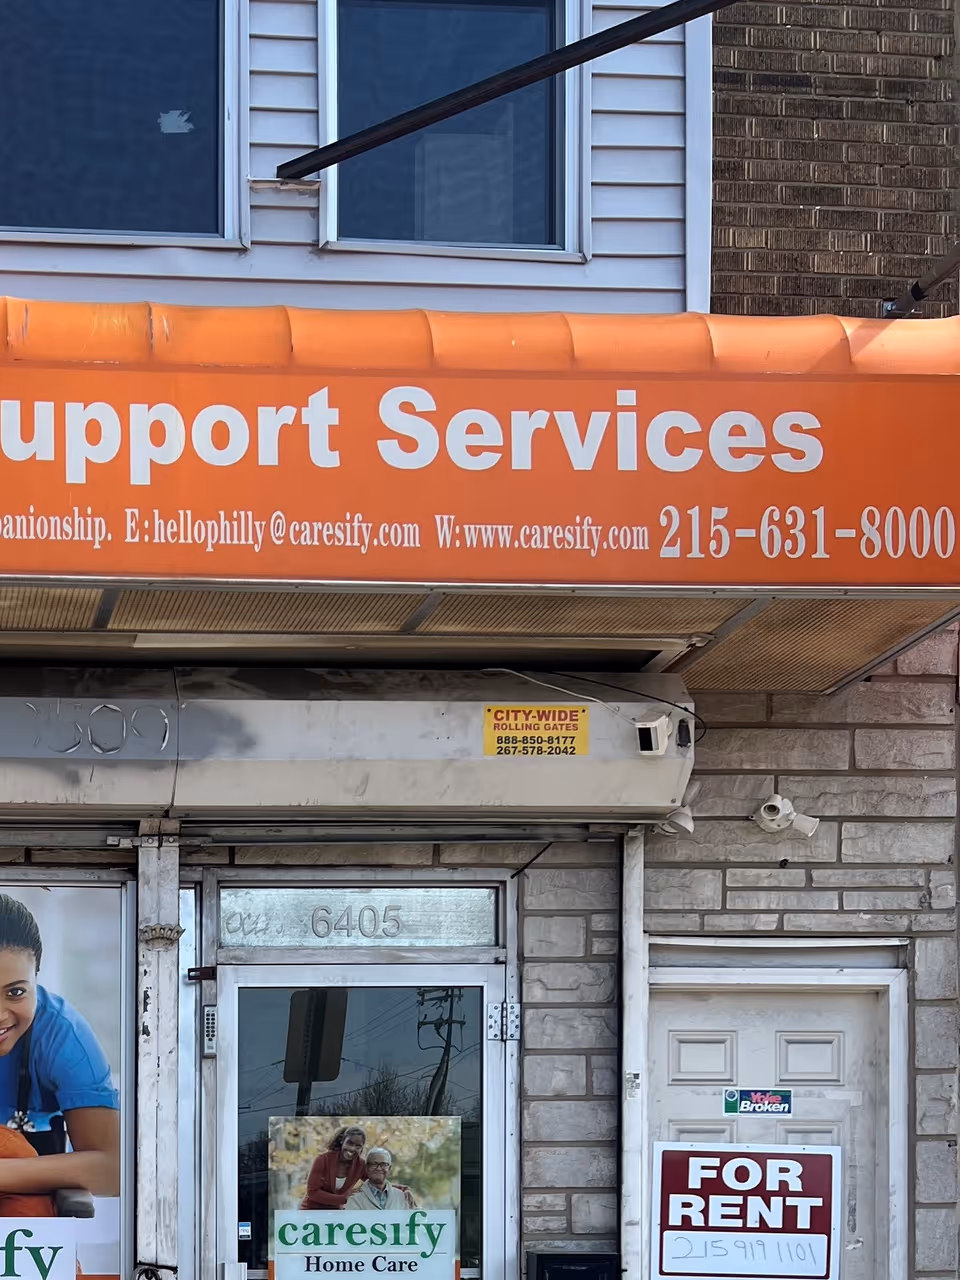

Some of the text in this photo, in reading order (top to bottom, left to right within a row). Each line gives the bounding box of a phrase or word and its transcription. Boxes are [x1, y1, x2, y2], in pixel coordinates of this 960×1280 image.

[377, 386, 825, 474] Services
[659, 504, 957, 560] 215-631-8000
[494, 710, 578, 722] CITY-WIDE
[494, 723, 578, 732] ROLLING GATES
[496, 736, 576, 745] 888-850-8177
[496, 746, 576, 756] 267-578-2042
[311, 905, 402, 938] 6405
[740, 1101, 788, 1111] Broken
[688, 1157, 803, 1192] FOR
[668, 1194, 823, 1229] RENT
[278, 1211, 447, 1258] caresify
[304, 1256, 418, 1273] Home Care
